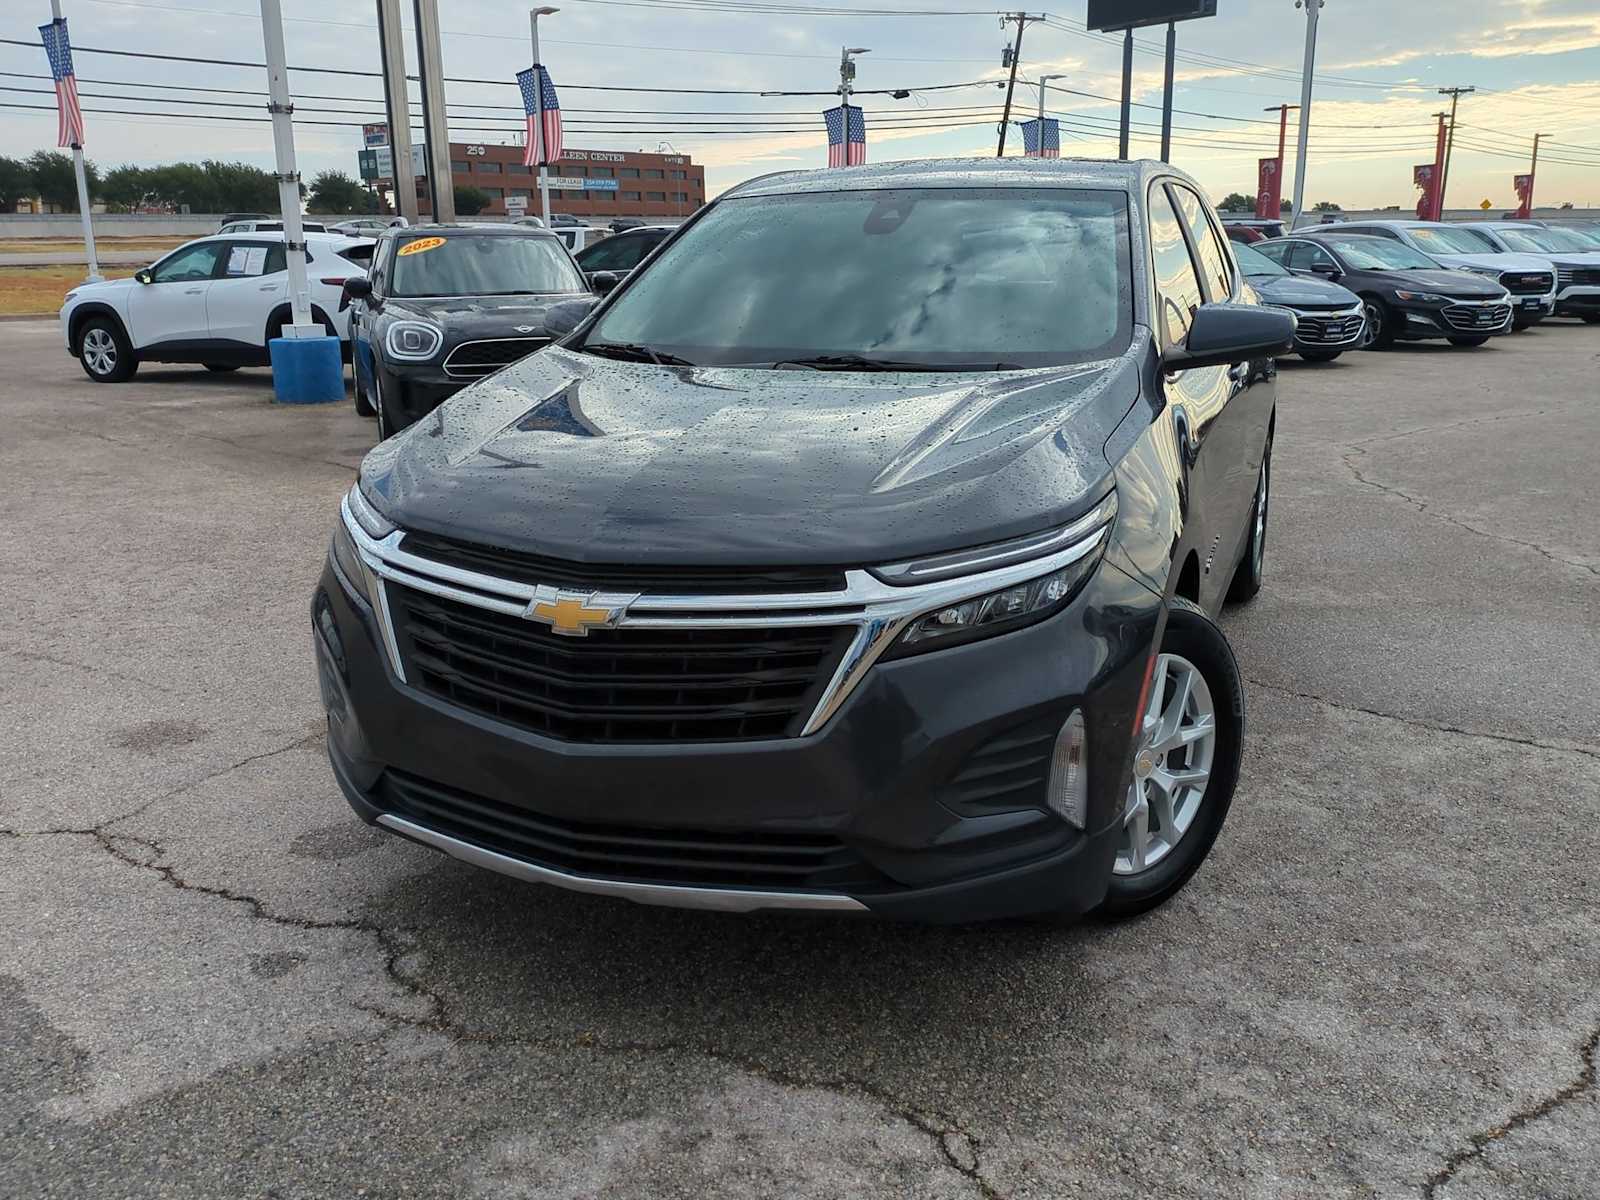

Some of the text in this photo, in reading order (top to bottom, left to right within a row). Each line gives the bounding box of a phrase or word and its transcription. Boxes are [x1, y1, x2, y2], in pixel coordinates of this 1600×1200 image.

[466, 145, 485, 156] 250
[591, 152, 625, 162] CENTER
[403, 238, 441, 254] 2023
